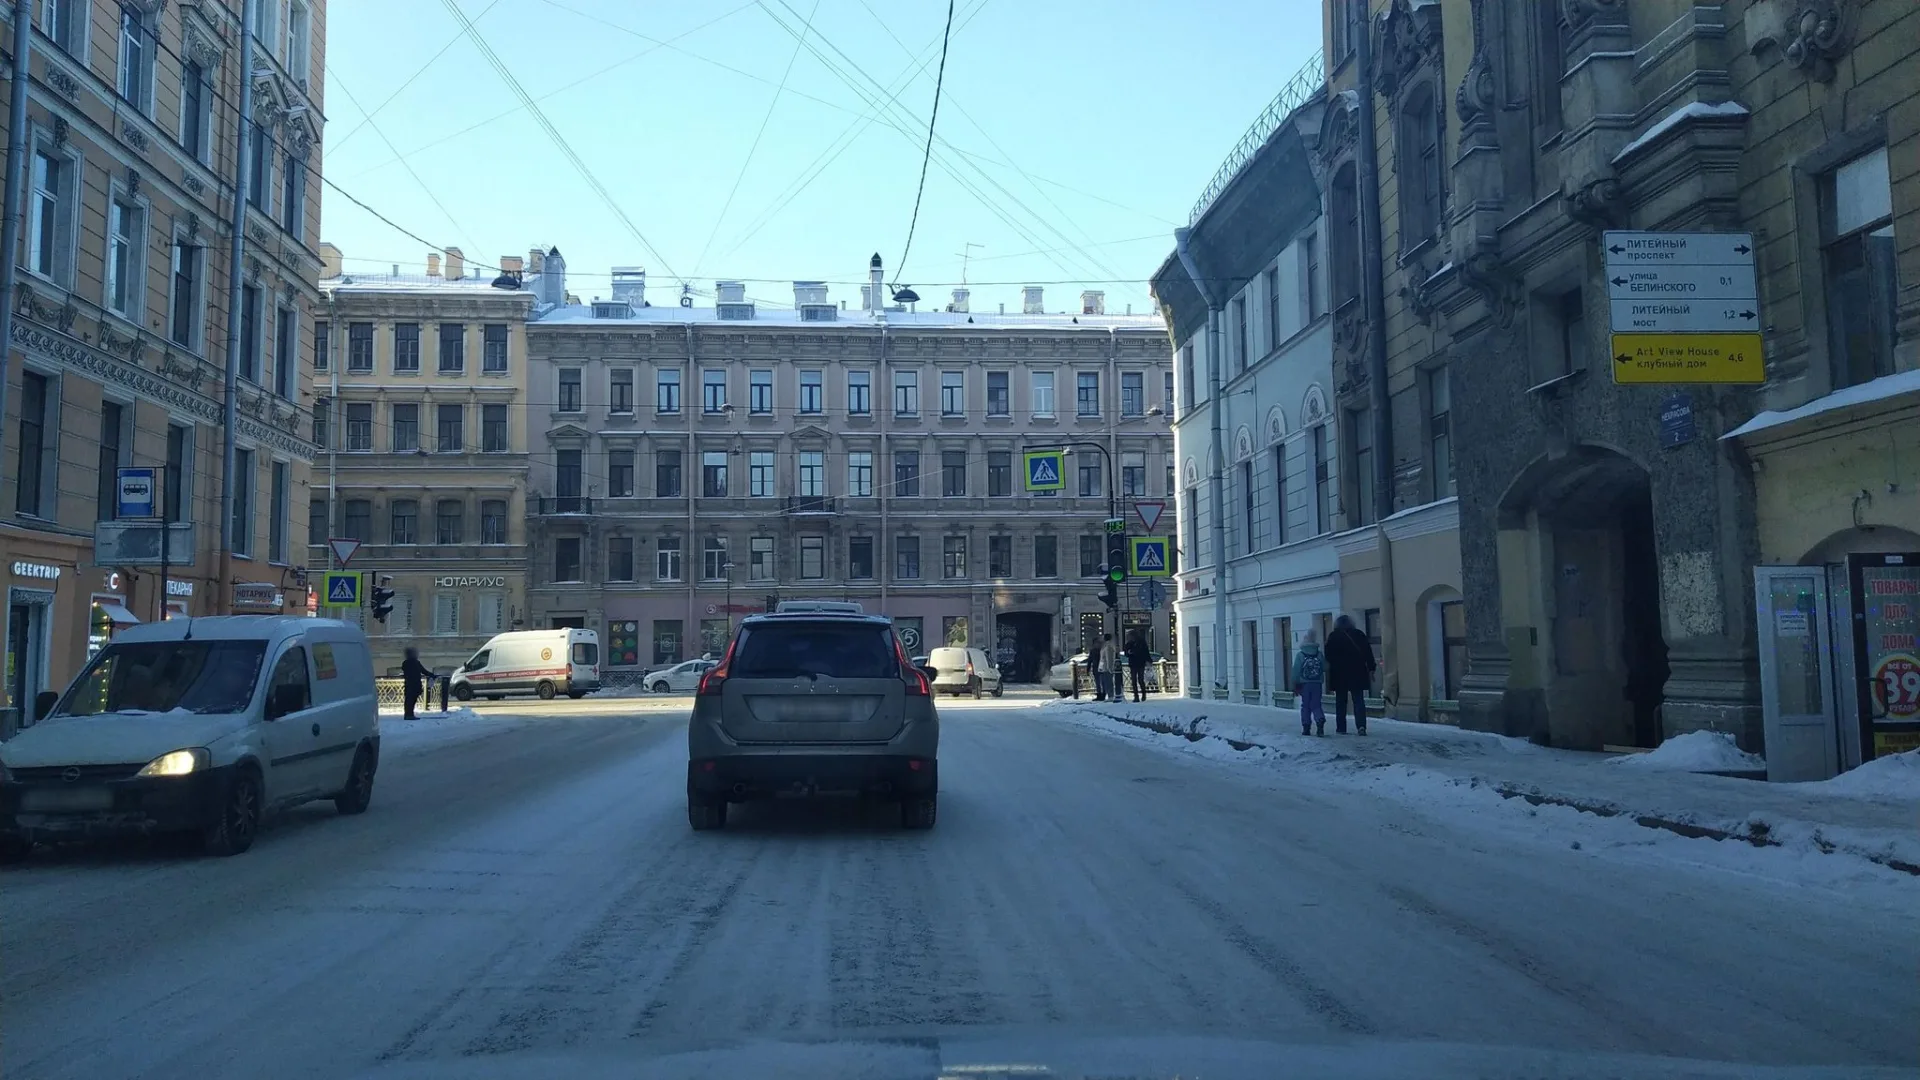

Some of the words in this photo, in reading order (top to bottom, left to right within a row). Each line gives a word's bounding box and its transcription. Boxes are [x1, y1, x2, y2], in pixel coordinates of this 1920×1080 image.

[1627, 238, 1687, 249] ЛИТЕЙНЫЙ
[1627, 252, 1675, 261] проспект
[1629, 272, 1658, 281] улица
[1720, 276, 1732, 286] 0,1
[1630, 283, 1696, 292] БЕЛИНСКОГО
[1632, 304, 1690, 315] ЛИТЕЙНЫЙ
[1723, 310, 1736, 320] 1,2
[1636, 347, 1654, 356] Art
[1659, 347, 1683, 356] View
[1688, 346, 1720, 356] House
[1728, 353, 1744, 362] 4,6
[1637, 359, 1683, 370] клубный
[1687, 360, 1707, 369] дом
[14, 561, 61, 579] GEEKTRIP
[434, 576, 505, 587] НОТАРИУС
[1871, 579, 1918, 596] ТОВАРЫ
[236, 589, 272, 599] НОТАРИУС
[1885, 604, 1909, 620] ДЛЯ
[1882, 634, 1916, 651] ДОМА
[1884, 671, 1920, 704] 39
